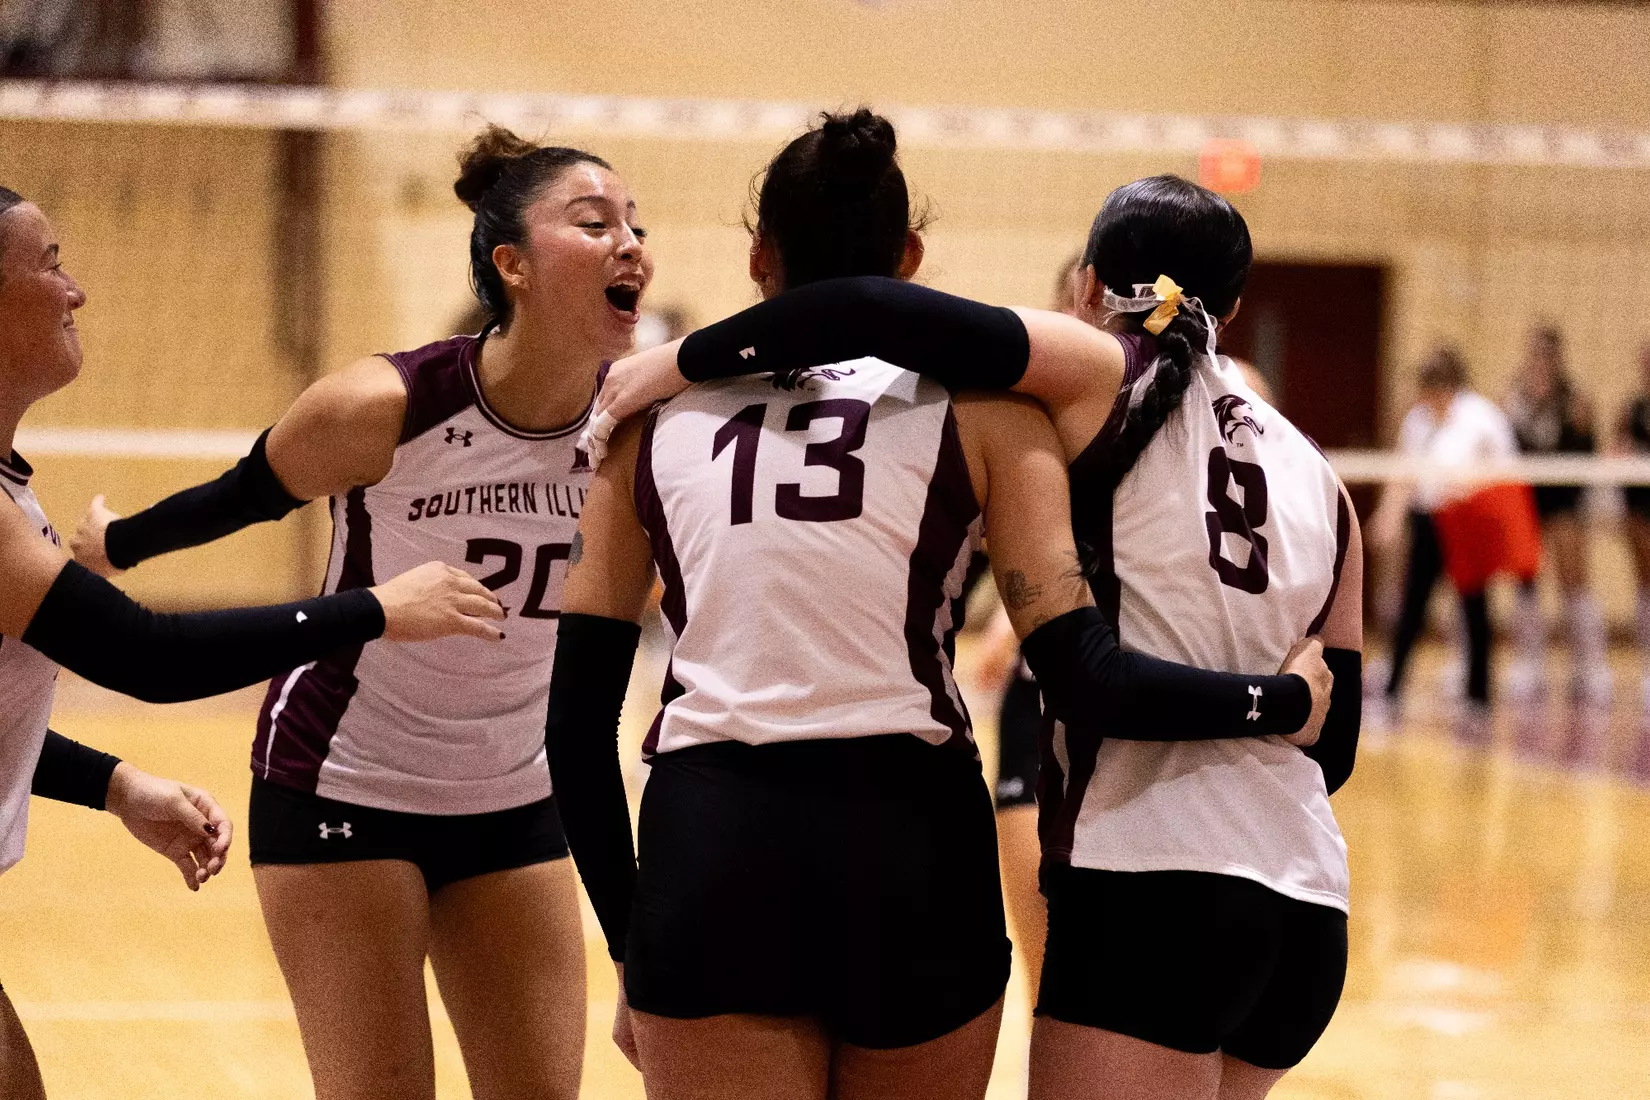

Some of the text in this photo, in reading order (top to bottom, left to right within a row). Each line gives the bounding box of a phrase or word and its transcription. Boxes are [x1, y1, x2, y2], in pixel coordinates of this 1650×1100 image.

[408, 482, 538, 521] SOUTHERN
[712, 398, 871, 526] 13
[1205, 446, 1269, 595] 8
